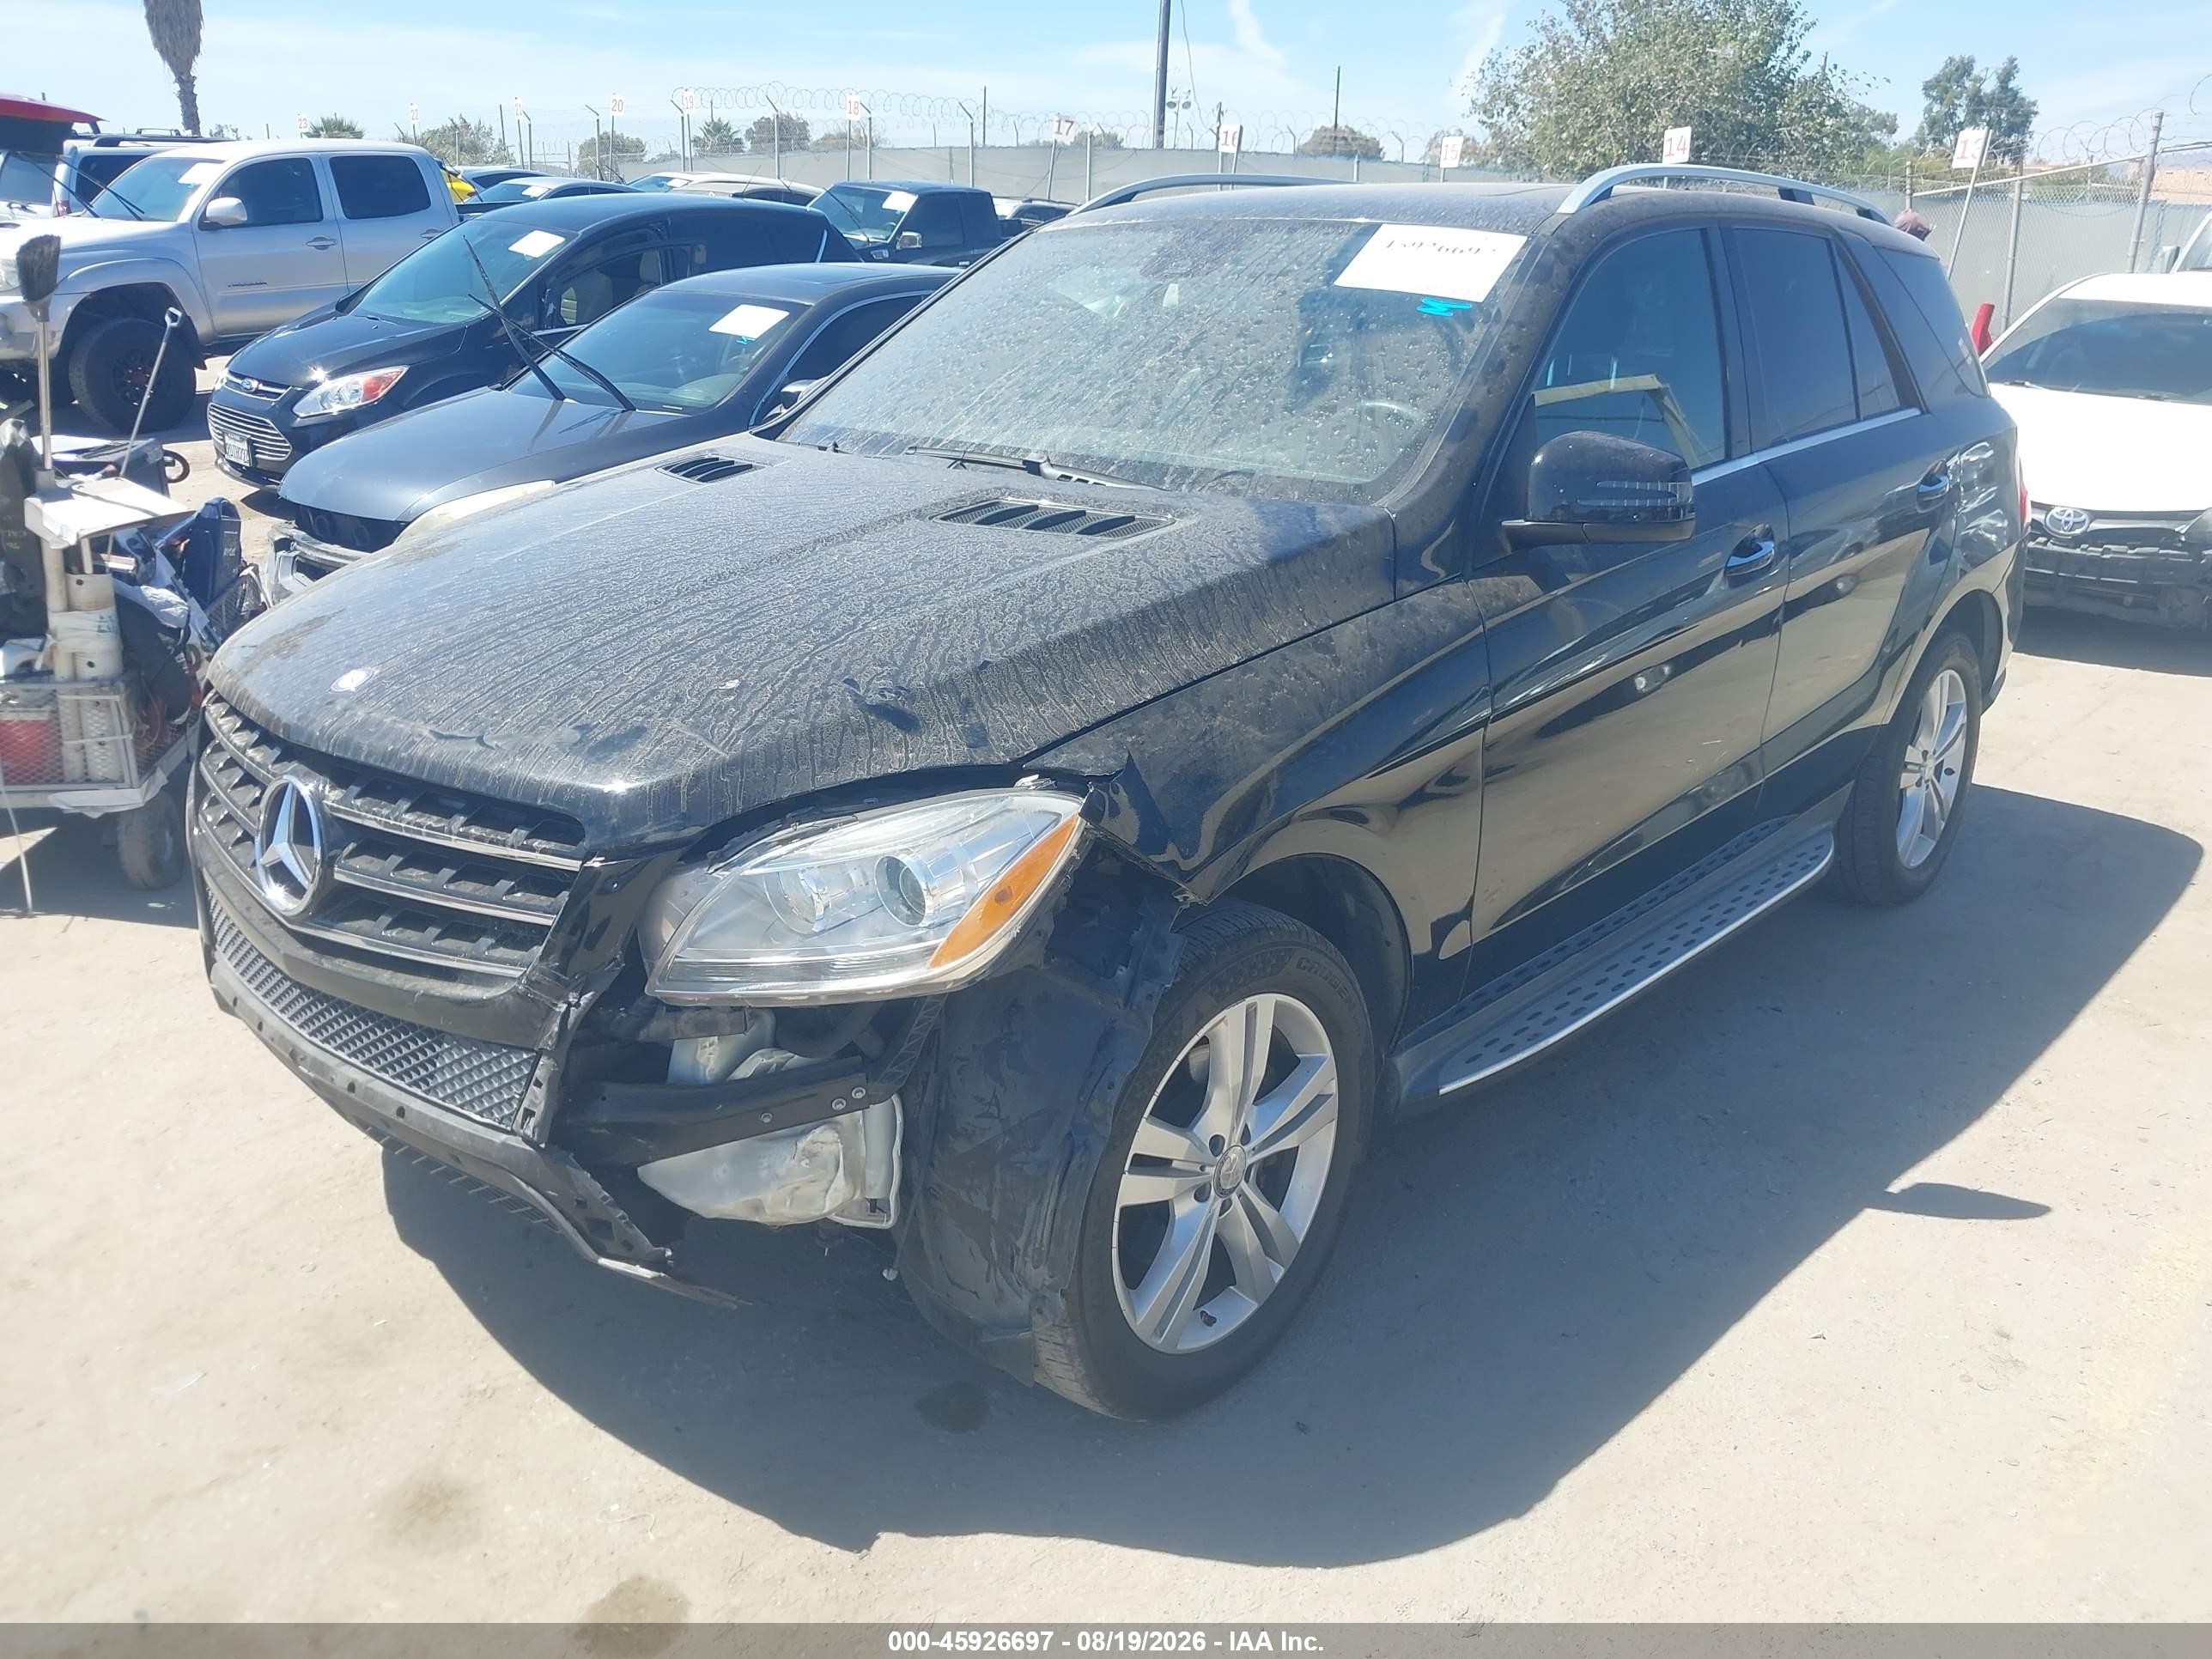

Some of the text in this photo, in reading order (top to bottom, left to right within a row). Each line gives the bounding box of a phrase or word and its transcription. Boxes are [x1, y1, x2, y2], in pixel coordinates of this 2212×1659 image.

[611, 99, 623, 112] 20
[684, 95, 694, 110] 19
[848, 100, 860, 116] 18
[410, 109, 419, 121] 22
[297, 118, 308, 129] 23
[1054, 119, 1074, 137] 17
[1443, 143, 1459, 161] 15
[1665, 135, 1686, 157] 14
[1295, 956, 1356, 1007] CRUGE
